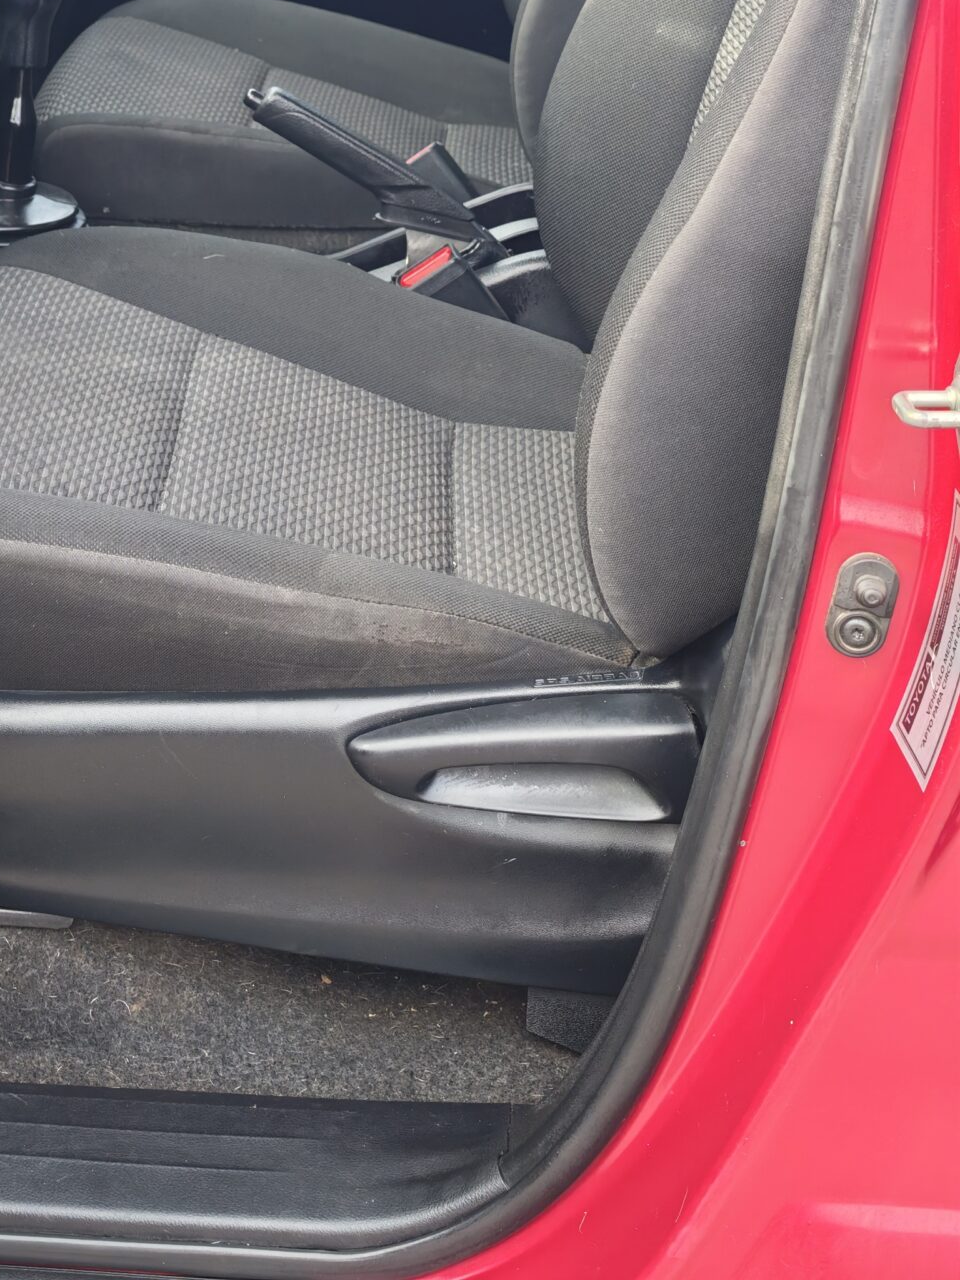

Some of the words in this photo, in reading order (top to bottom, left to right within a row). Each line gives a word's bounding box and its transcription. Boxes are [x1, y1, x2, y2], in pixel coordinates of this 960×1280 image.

[943, 614, 958, 664] MEDIANO
[904, 660, 932, 724] TOYOTA
[932, 692, 944, 718] PARA
[942, 639, 959, 690] CIRCULAR
